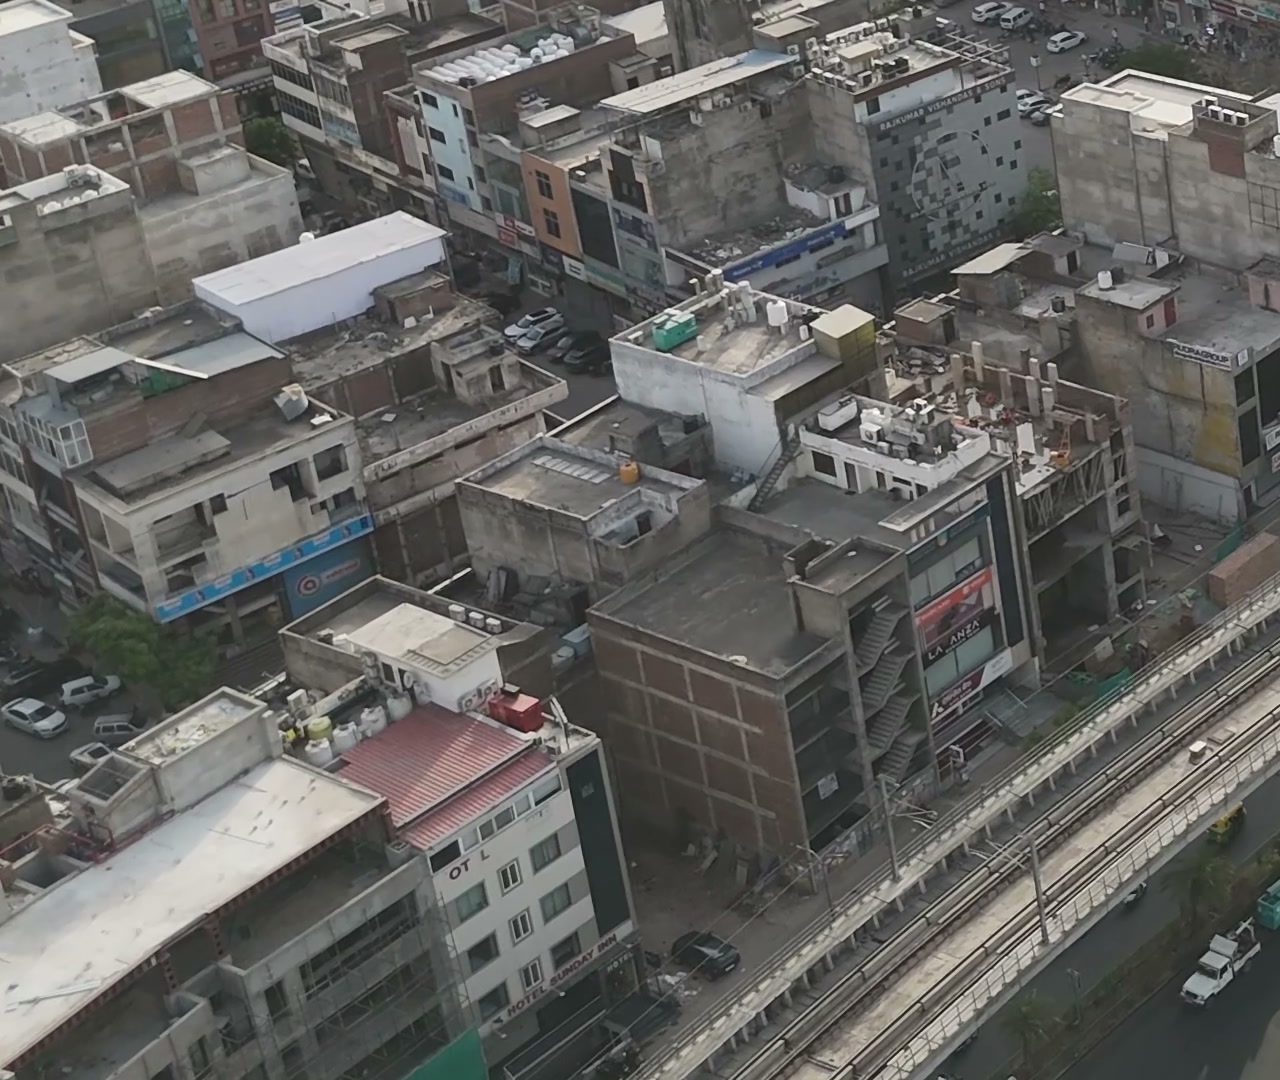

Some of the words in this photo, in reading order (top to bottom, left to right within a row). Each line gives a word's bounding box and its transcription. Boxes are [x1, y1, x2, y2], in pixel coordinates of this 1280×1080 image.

[880, 108, 924, 131] RAJKUMAR
[984, 77, 1007, 90] SONS
[507, 984, 546, 1016] HOTEL
[549, 949, 594, 986] SUNDAY
[597, 933, 617, 953] INN
